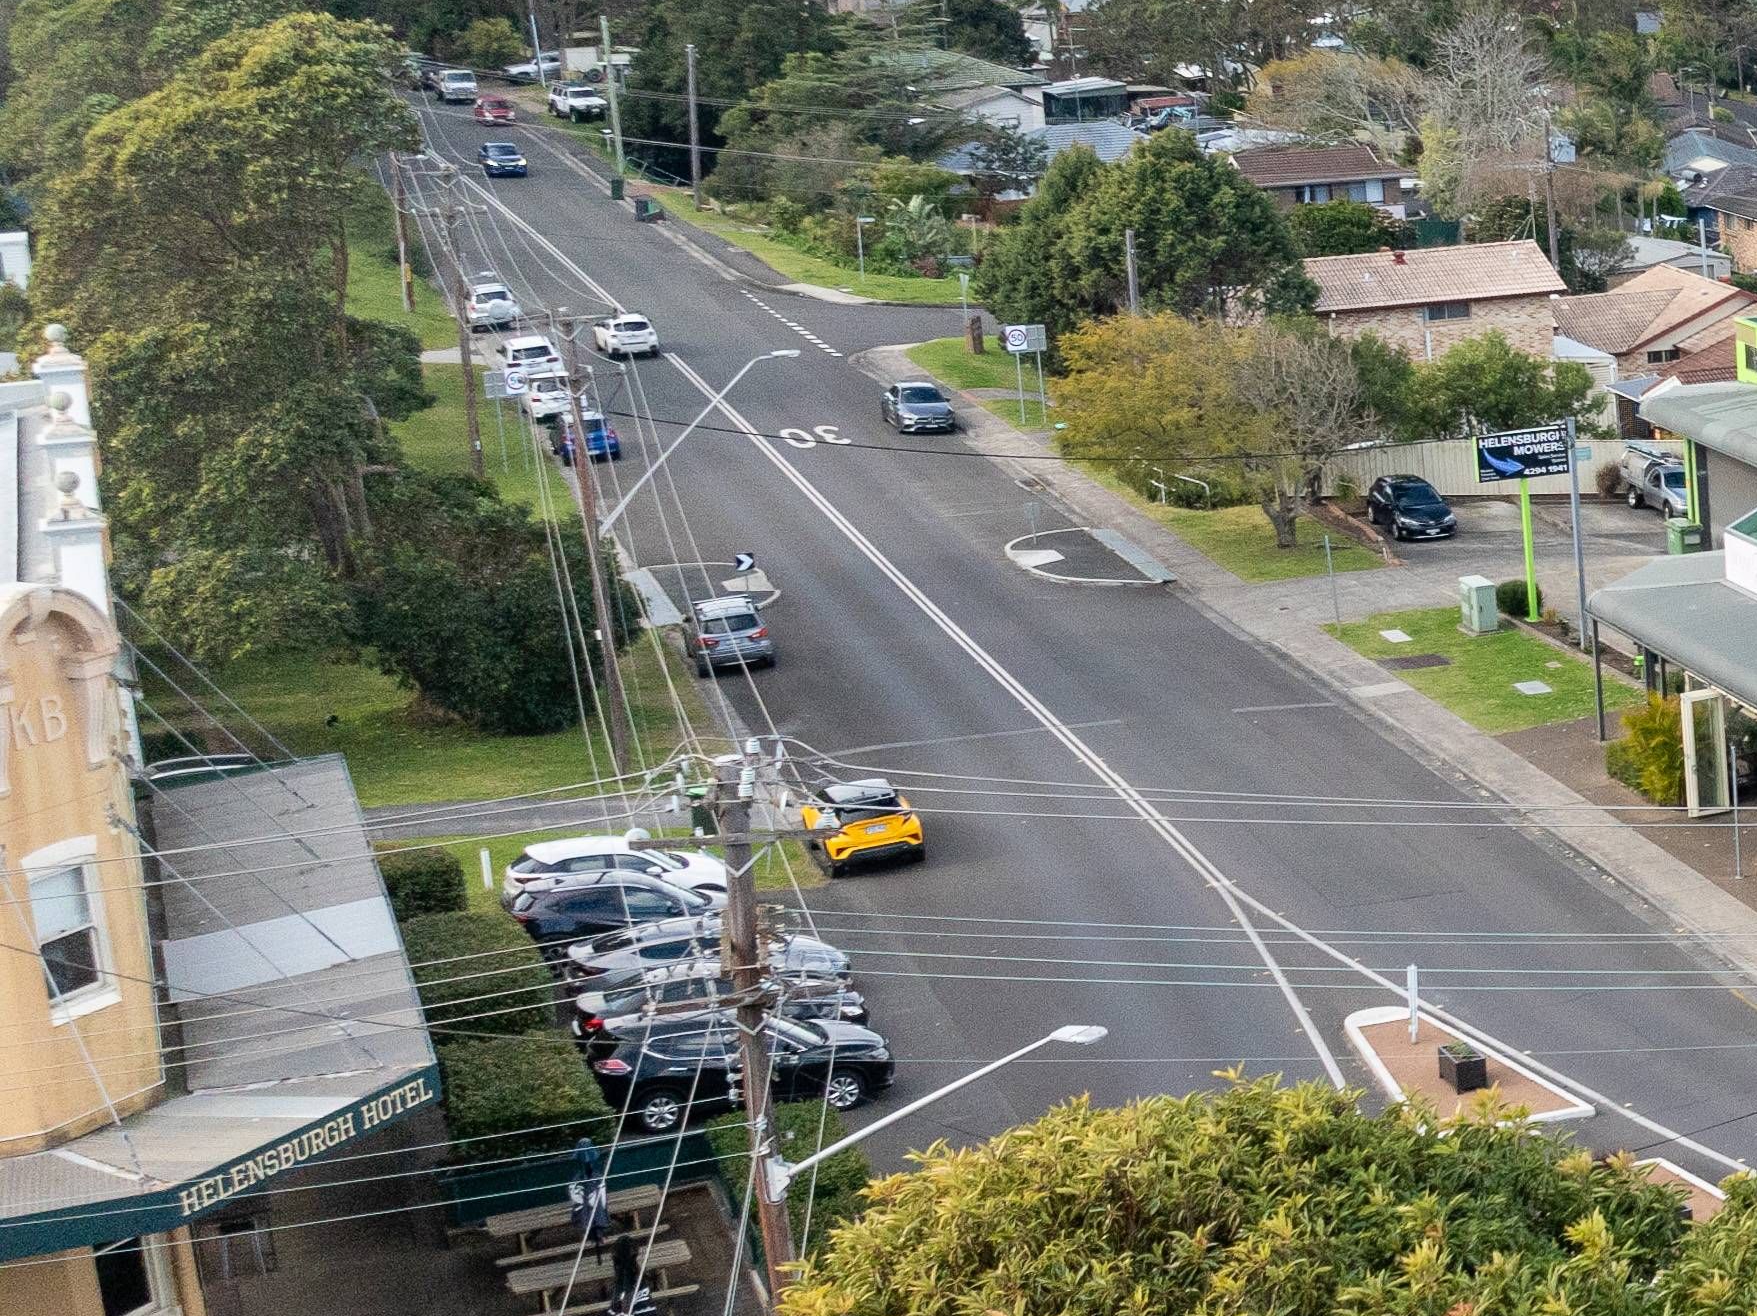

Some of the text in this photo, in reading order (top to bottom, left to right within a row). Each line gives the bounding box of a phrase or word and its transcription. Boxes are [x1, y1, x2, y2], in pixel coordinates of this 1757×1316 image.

[1513, 441, 1566, 456] MOWERS
[1523, 466, 1547, 475] 4294
[178, 1077, 433, 1217] HELENSBURGH HOTEL
